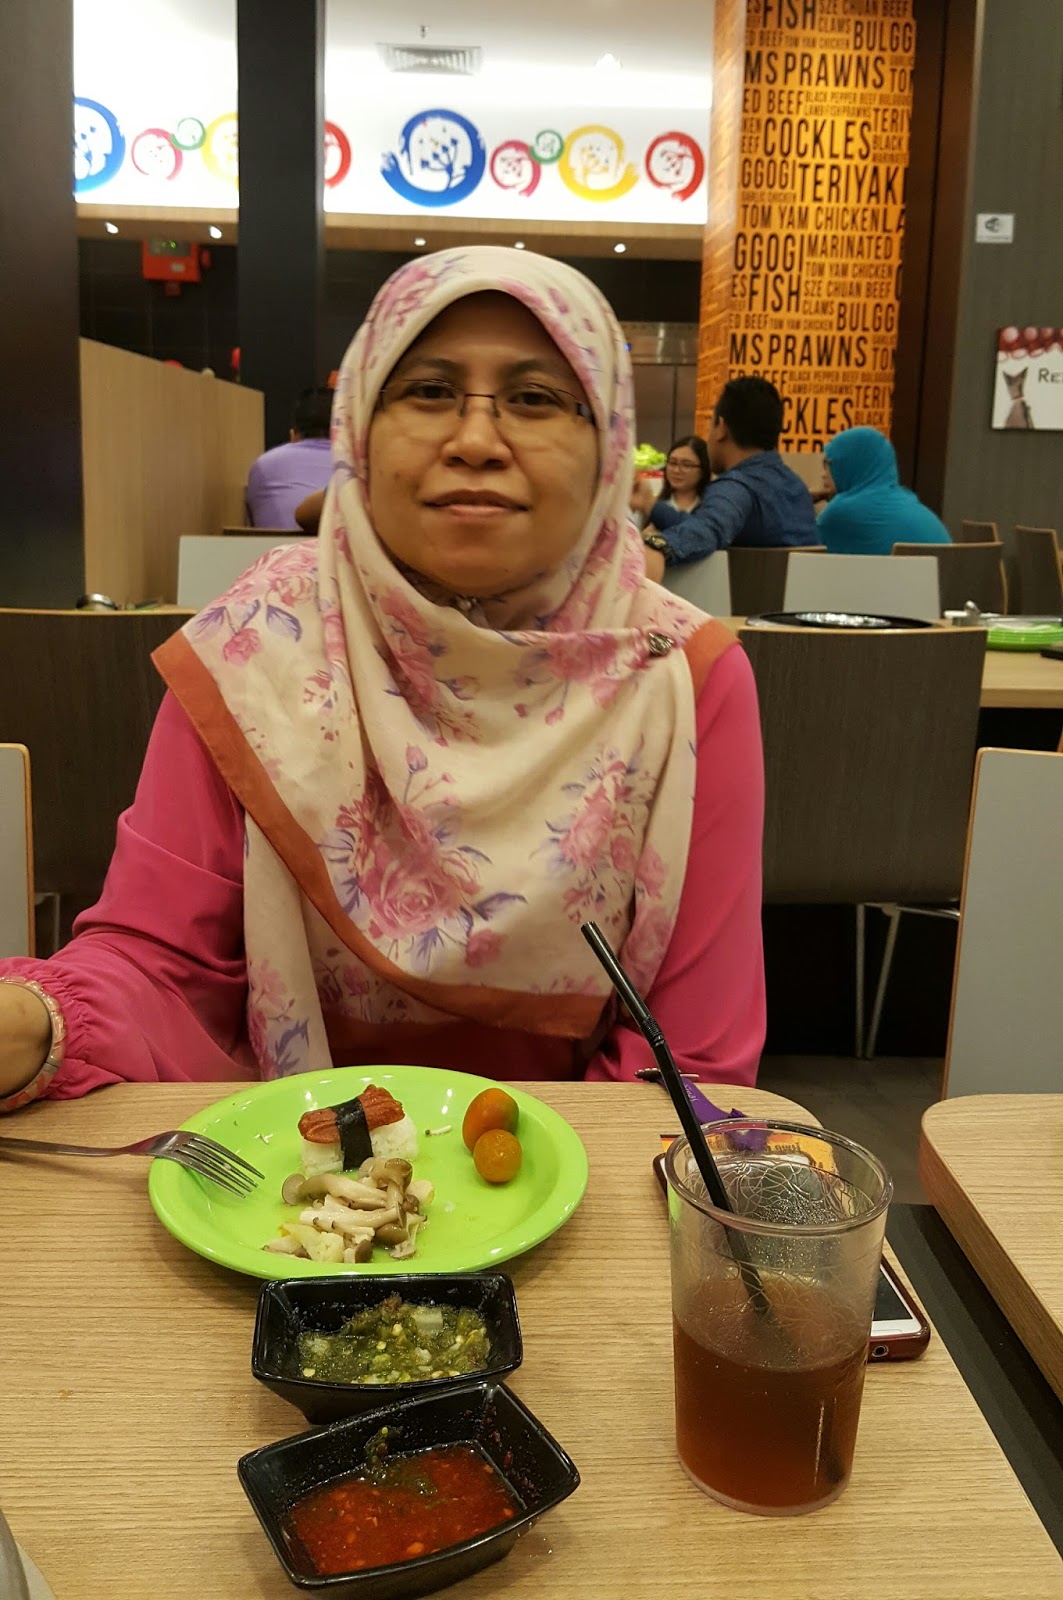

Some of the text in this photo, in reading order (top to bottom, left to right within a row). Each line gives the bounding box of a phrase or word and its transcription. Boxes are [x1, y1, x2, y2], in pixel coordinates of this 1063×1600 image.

[853, 20, 913, 53] BULGG
[783, 52, 885, 89] PRAWNS
[767, 90, 803, 115] BEEF
[764, 118, 871, 160] COCKLES
[741, 158, 796, 190] GGOGI
[741, 204, 771, 229] TOM
[778, 205, 809, 230] YAM
[734, 233, 804, 272] GGOGI
[805, 235, 893, 260] MARINATED
[731, 274, 747, 298] ES
[852, 263, 893, 279] CHICKEN
[748, 273, 801, 313] FISH
[865, 282, 892, 298] BEEF
[836, 302, 895, 333] BULGG
[768, 334, 867, 367] PRAWNS
